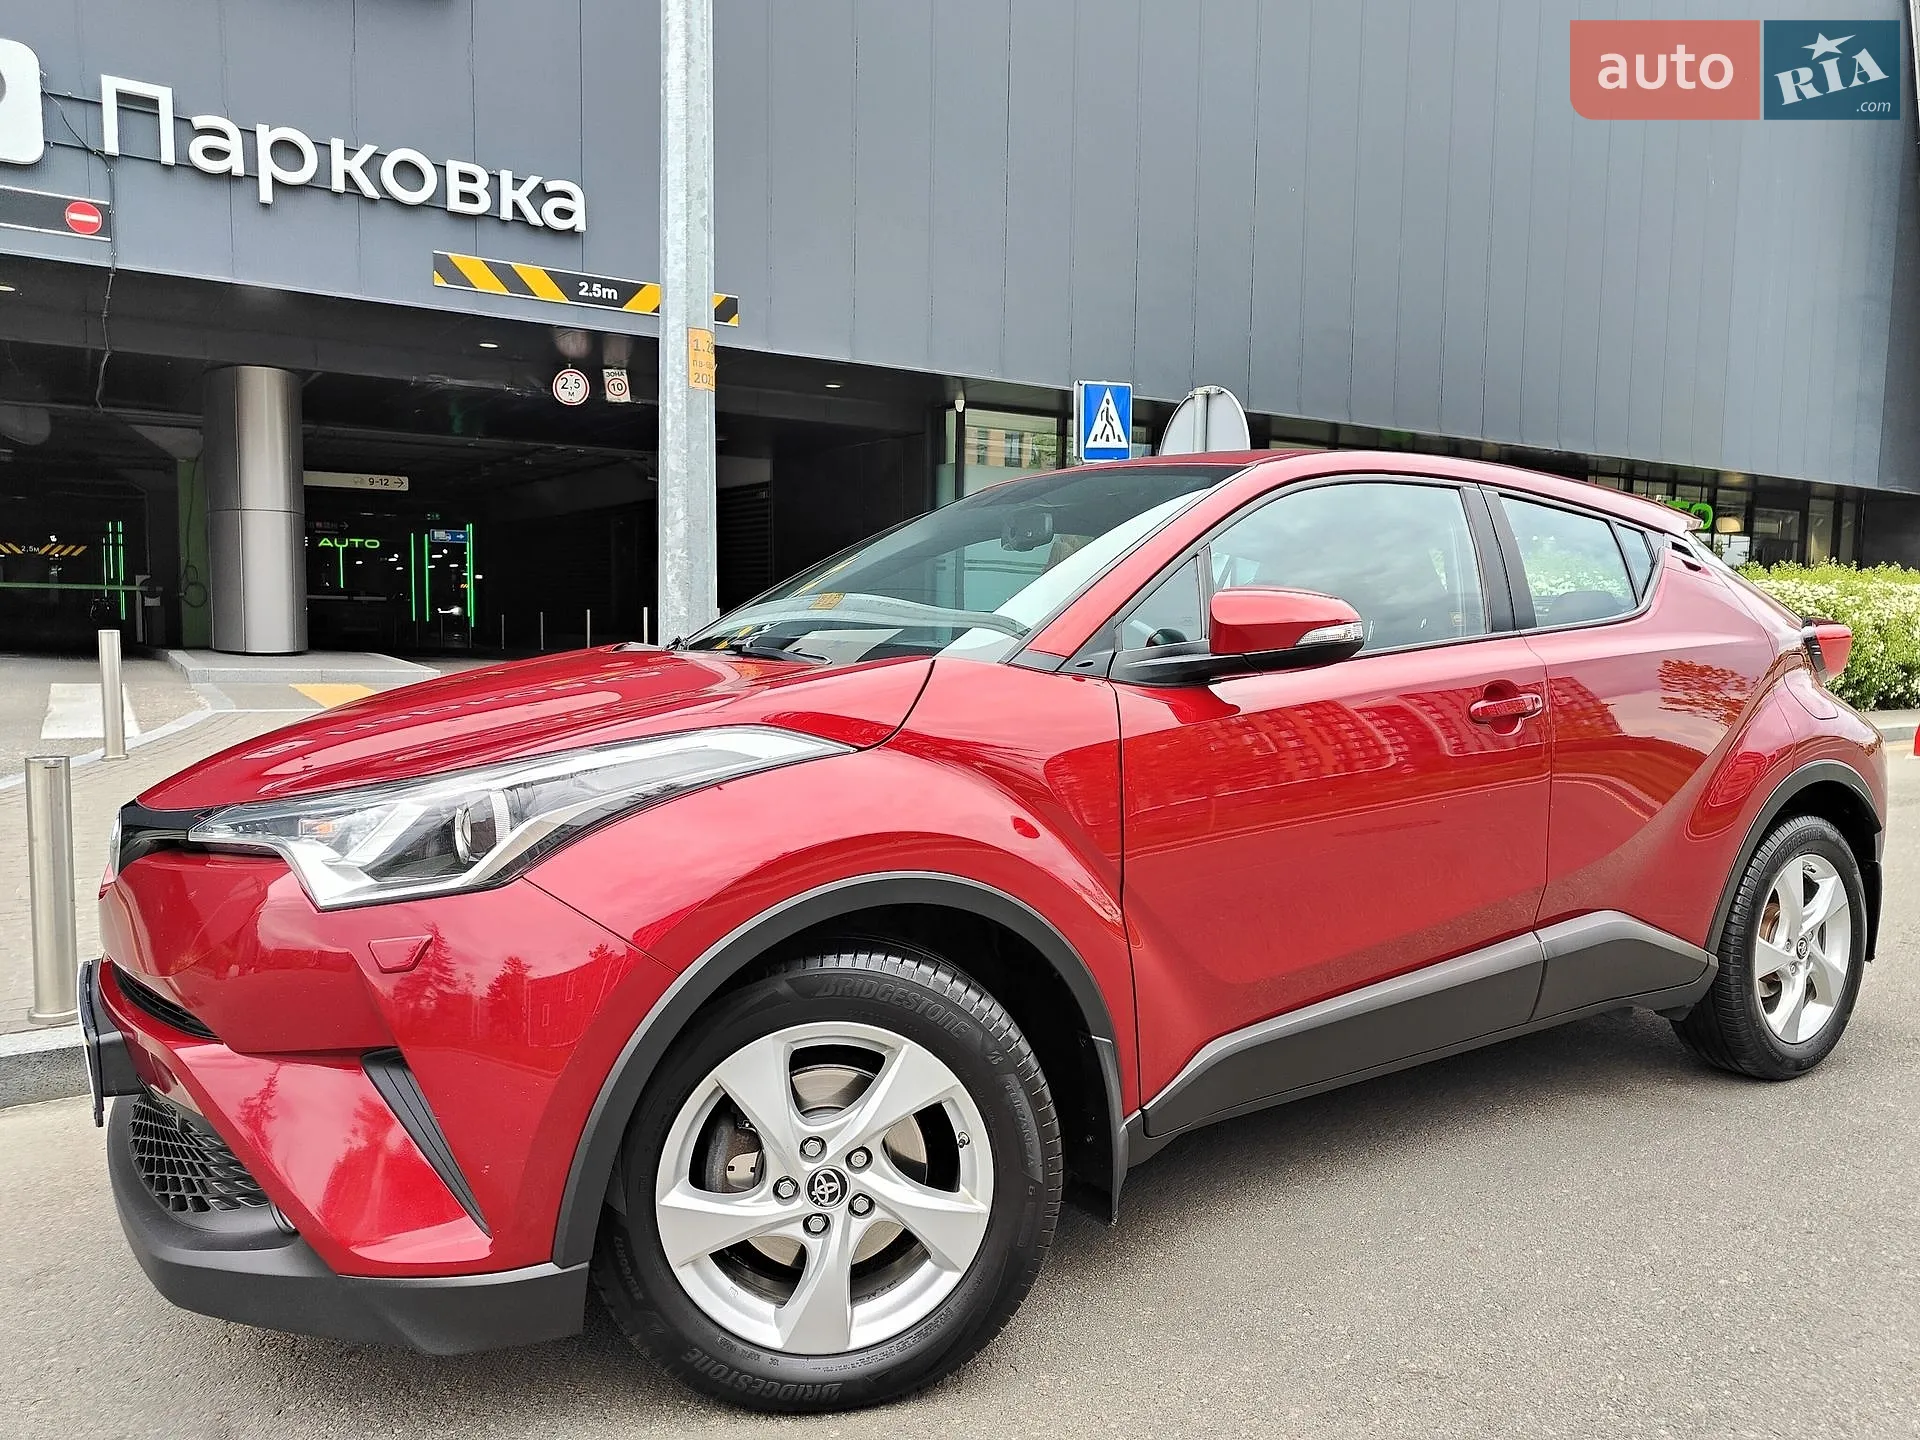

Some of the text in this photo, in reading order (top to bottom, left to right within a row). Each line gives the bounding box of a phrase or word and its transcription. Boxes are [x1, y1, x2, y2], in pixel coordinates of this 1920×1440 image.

[101, 74, 588, 234] Парковка
[578, 281, 618, 300] 2.5m
[560, 376, 581, 391] 2,5
[610, 382, 623, 392] 10
[367, 477, 390, 487] 9-12
[318, 537, 381, 549] AUTO
[815, 976, 974, 1041] BRIDGESTONE
[682, 1346, 843, 1402] BRIDGESTONE
